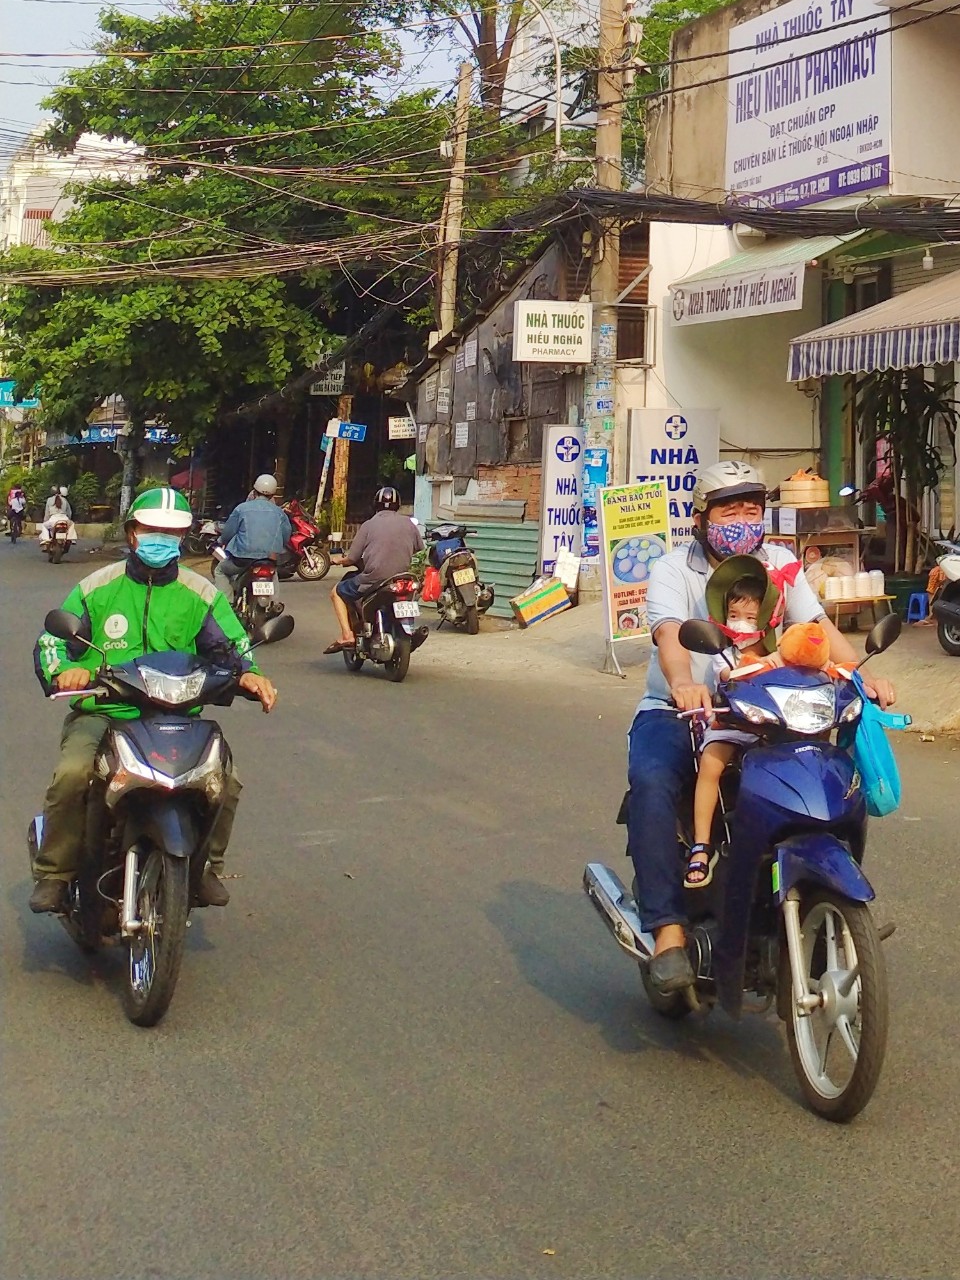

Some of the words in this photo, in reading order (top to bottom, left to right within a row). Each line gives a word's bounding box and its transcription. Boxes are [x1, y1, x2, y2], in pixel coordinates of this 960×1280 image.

[755, 22, 779, 55] NHÀ
[783, 1, 822, 40] THUỐC
[735, 63, 761, 124] HIẾU
[764, 52, 801, 114] NGHĨA
[805, 28, 878, 98] PHARMACY
[818, 103, 836, 122] GPP
[733, 153, 760, 174] CHUYÊN
[762, 148, 777, 165] BÁN
[788, 133, 813, 157] THUỐC
[814, 129, 828, 149] NỘI
[829, 124, 854, 142] NGOẠI
[856, 114, 879, 136] NHẬP
[688, 287, 704, 316] NHÀ
[705, 279, 731, 313] THUỐC
[733, 280, 749, 309] TÂY
[749, 273, 770, 307] HIẾU
[770, 272, 798, 304] NGHĨA
[526, 310, 548, 328] NHÀ
[551, 309, 585, 329] THUỐC
[527, 331, 549, 344] HIẾU
[553, 333, 583, 345] NGHĨA
[532, 347, 576, 356] PHARMACY
[650, 444, 699, 465] NHÀ
[556, 474, 577, 496] NHÀ
[637, 502, 651, 512] KIM
[553, 532, 575, 553] TÂY
[613, 590, 637, 599] HOTLINE:
[103, 639, 128, 650] Grab
[795, 745, 822, 753] HONDA
